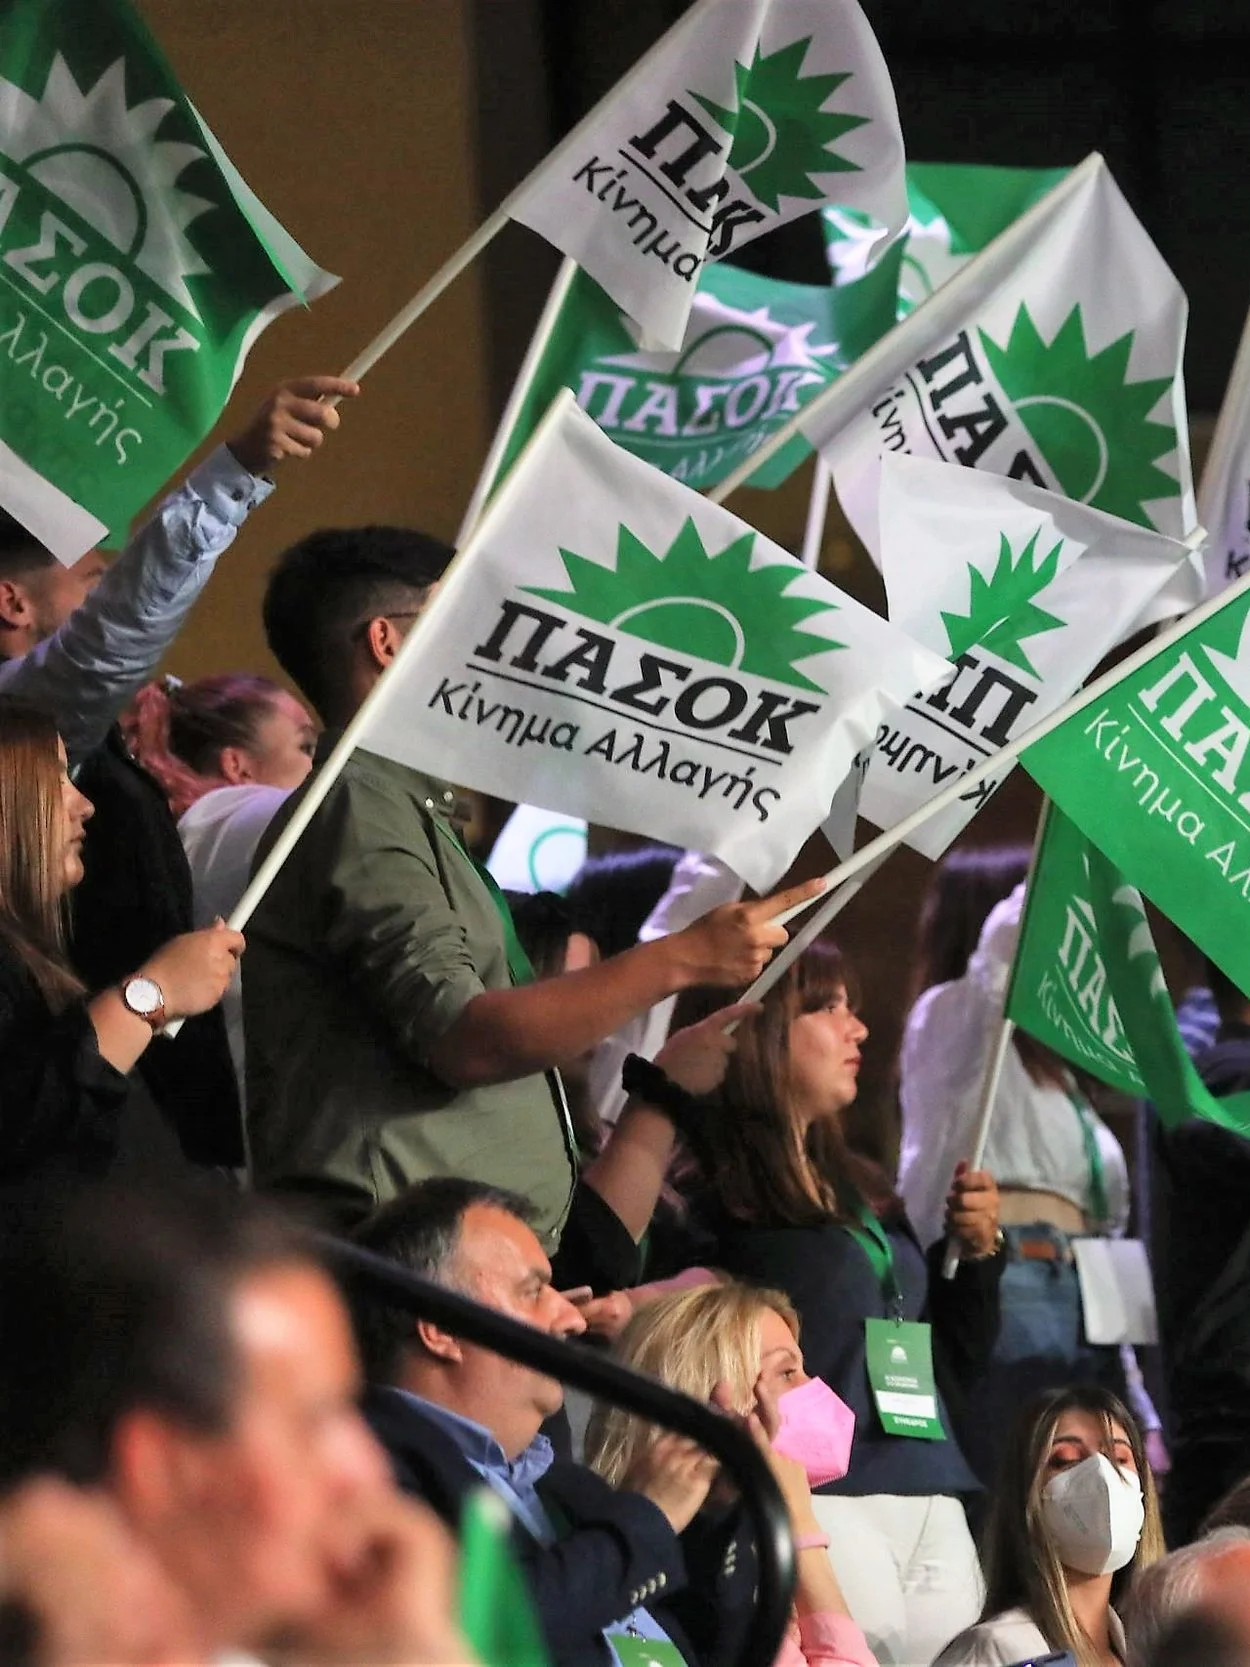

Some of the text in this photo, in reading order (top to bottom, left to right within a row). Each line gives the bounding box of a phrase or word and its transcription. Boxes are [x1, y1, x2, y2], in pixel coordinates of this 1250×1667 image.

[572, 156, 706, 282] Κίνημα
[0, 312, 143, 465] λλαγής
[576, 370, 826, 437] ΠΑΣΟΚ
[473, 599, 822, 756] ΠΑΣΟΚ
[427, 677, 782, 823] Κίνημα Αλλαγής
[1083, 708, 1207, 846] Κίνημα
